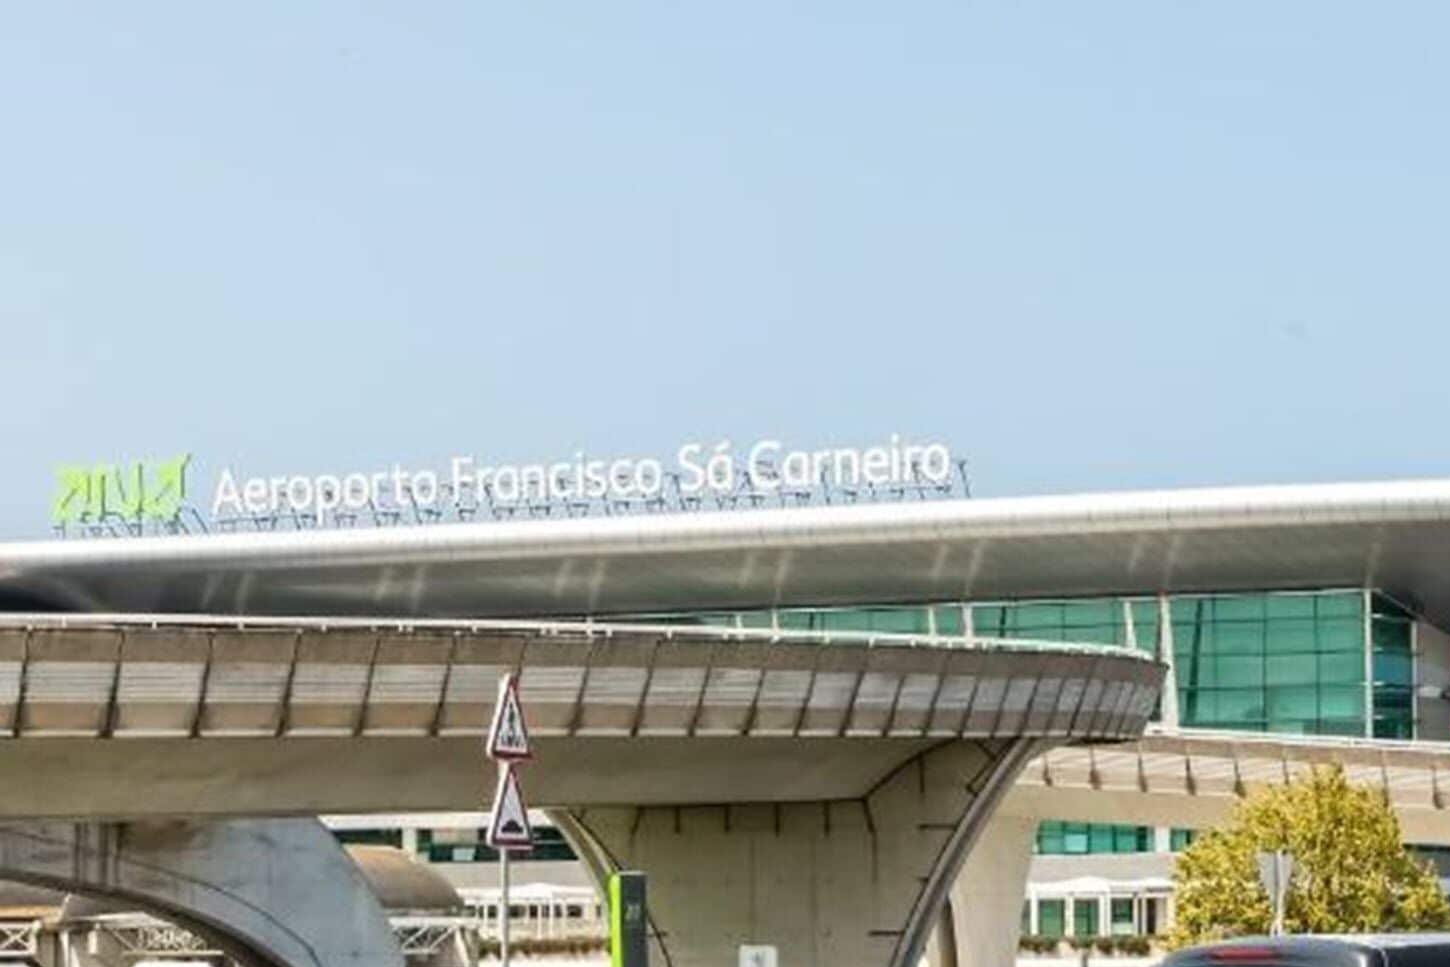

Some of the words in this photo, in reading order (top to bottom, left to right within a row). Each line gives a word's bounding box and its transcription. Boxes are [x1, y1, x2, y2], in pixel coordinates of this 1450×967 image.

[213, 466, 437, 526] Aeroporto
[451, 450, 662, 502] Francisco
[677, 439, 734, 492] Sá
[749, 431, 951, 489] Carneiro
